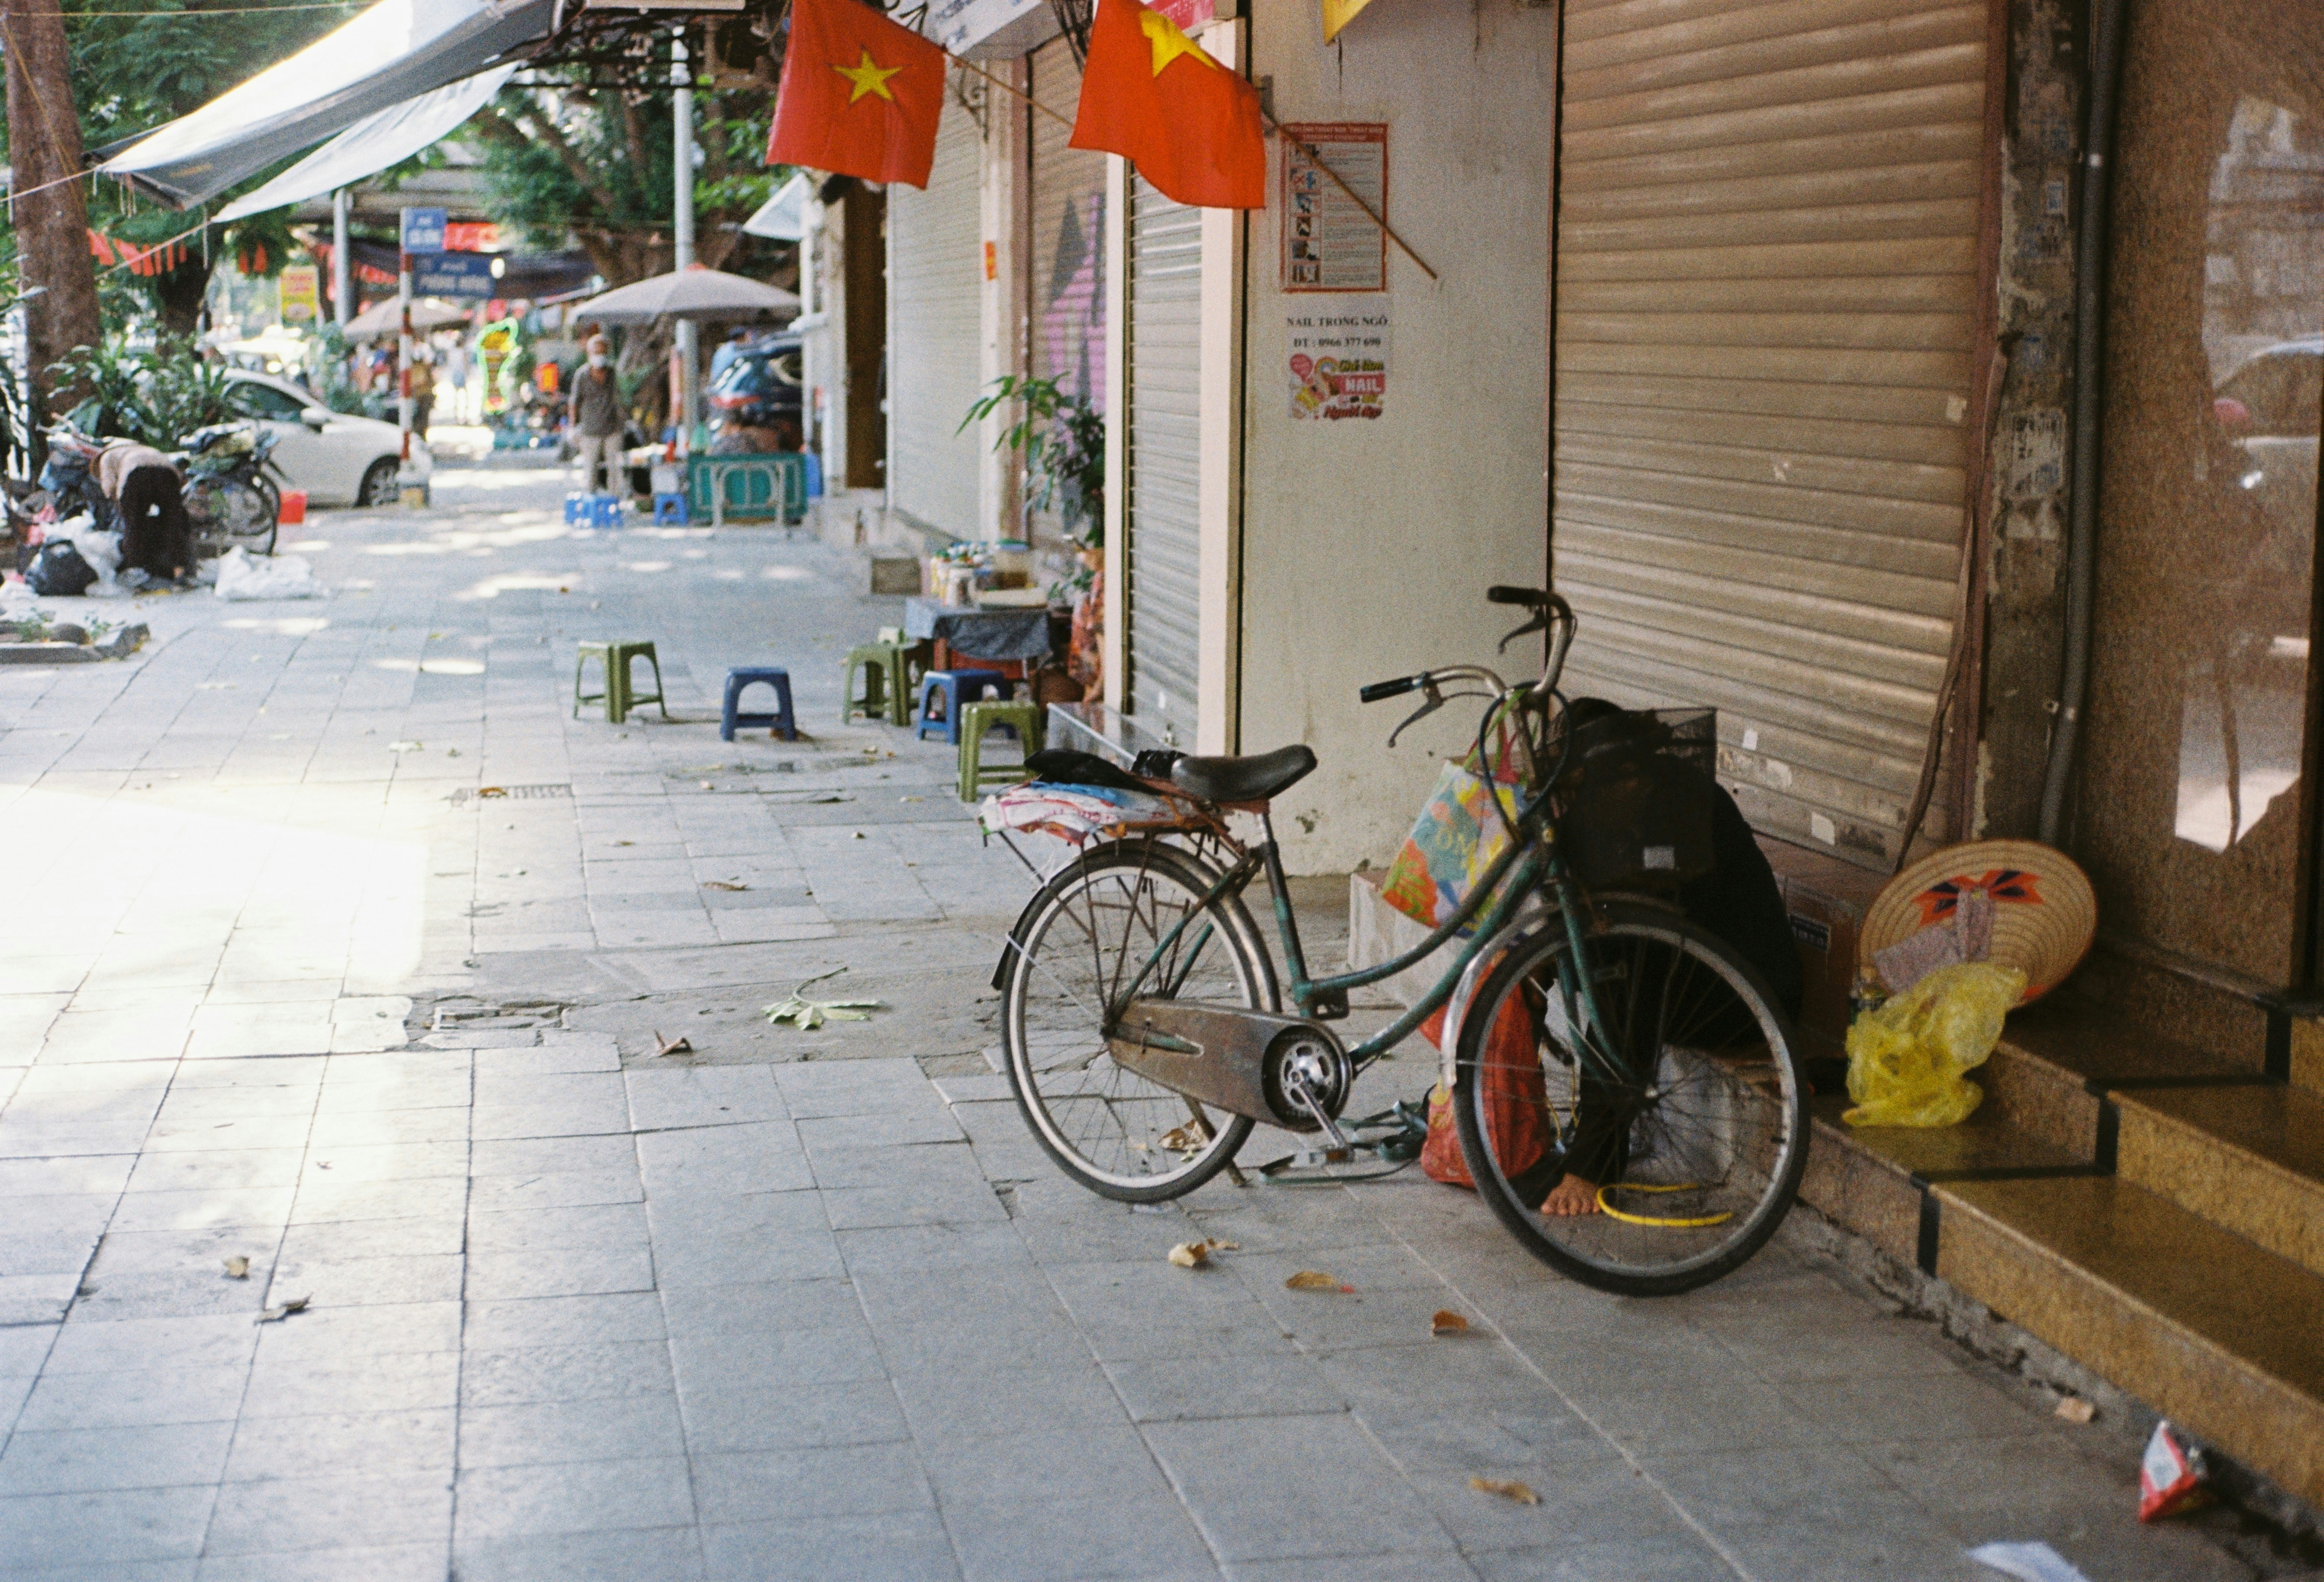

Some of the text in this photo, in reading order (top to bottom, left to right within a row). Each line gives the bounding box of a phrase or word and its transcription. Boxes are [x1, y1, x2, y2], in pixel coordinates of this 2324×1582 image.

[1287, 317, 1313, 326] NAIL
[1318, 317, 1359, 326] TRONG
[1345, 378, 1382, 393] NAIL
